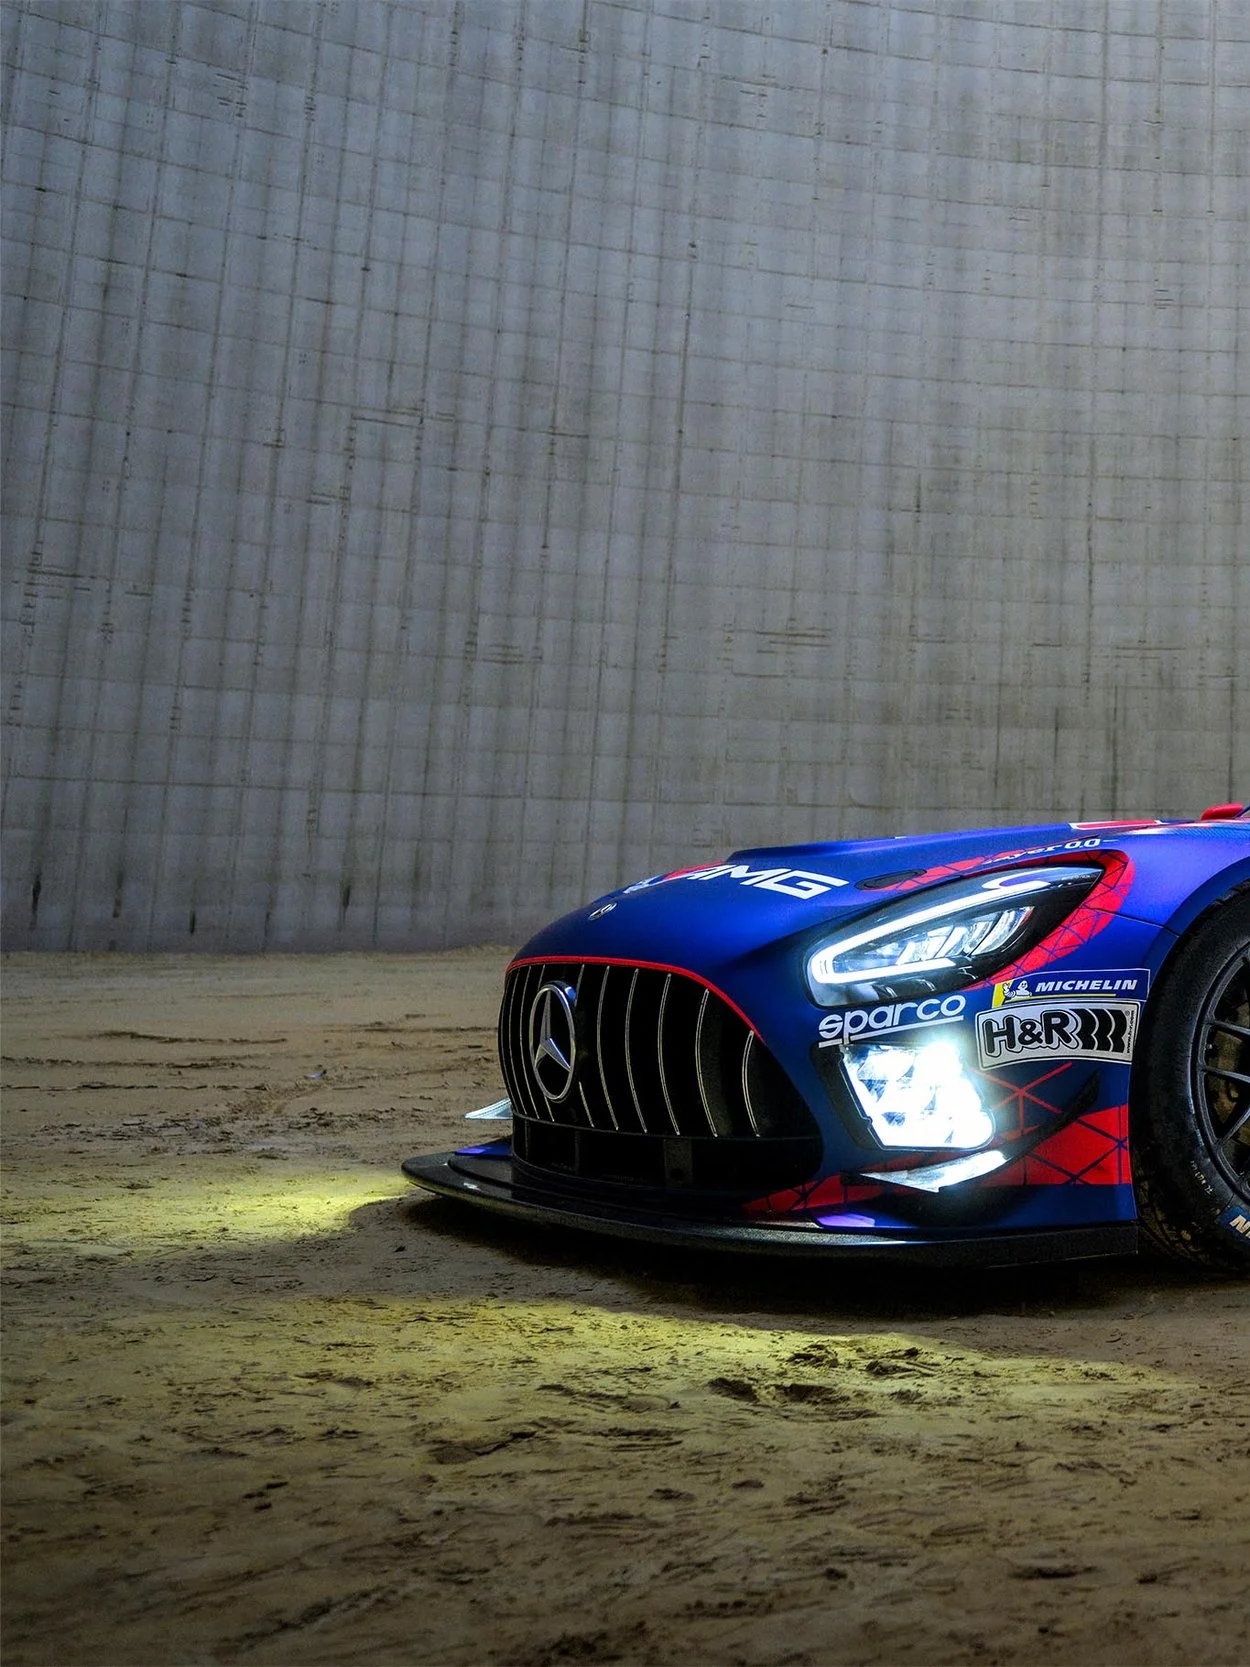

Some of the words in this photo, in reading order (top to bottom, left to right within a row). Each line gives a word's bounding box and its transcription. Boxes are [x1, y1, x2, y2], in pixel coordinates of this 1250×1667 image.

[682, 864, 850, 900] AMG
[1035, 979, 1138, 992] MICHELIN
[818, 995, 967, 1045] sparco
[984, 1008, 1082, 1058] H&R
